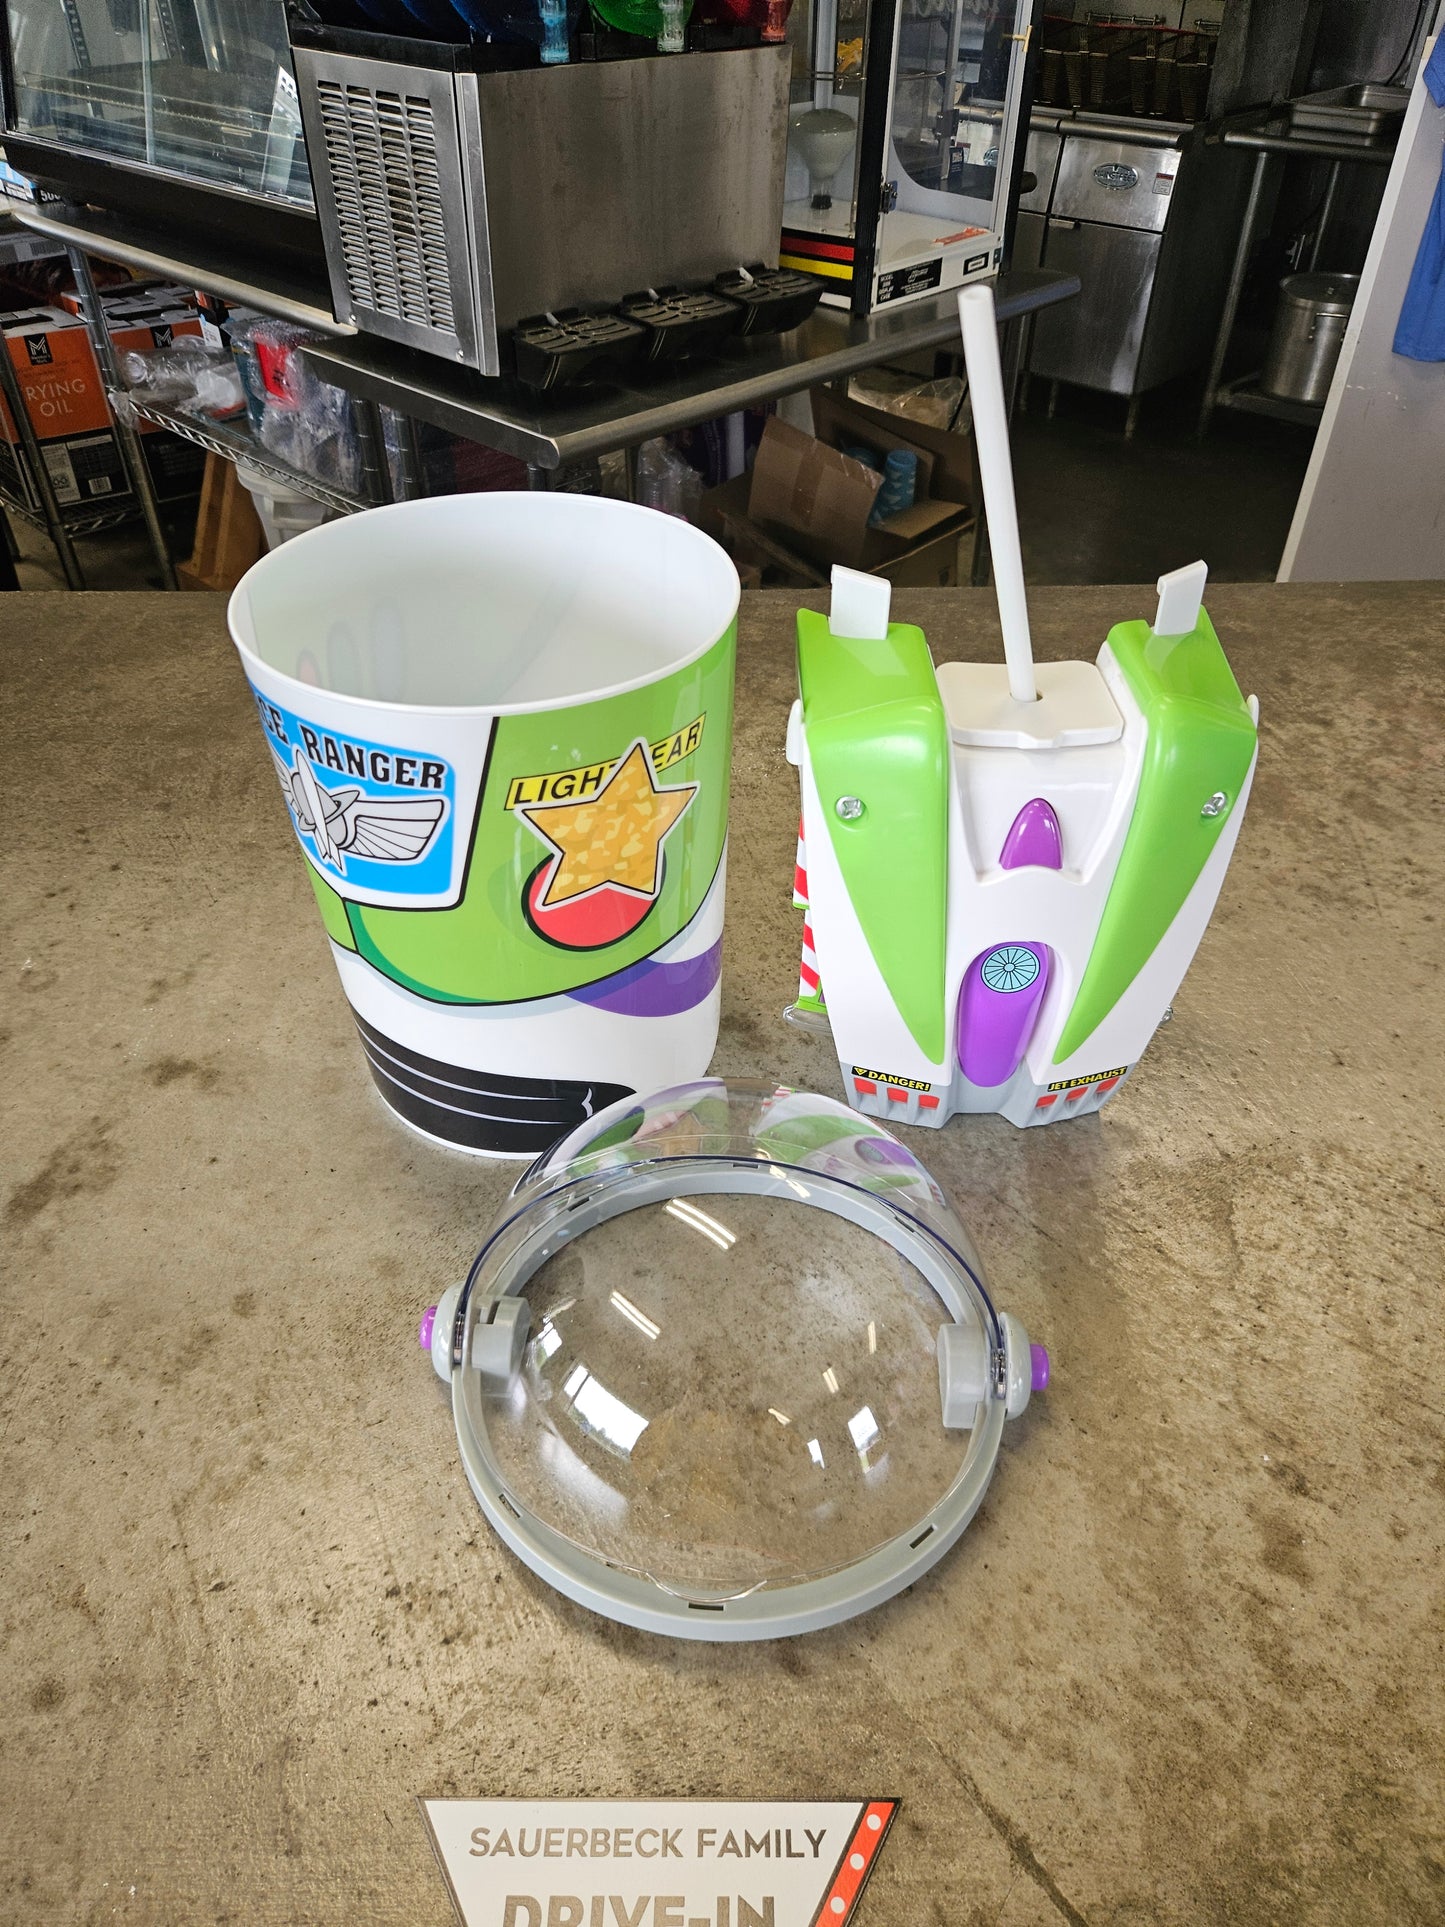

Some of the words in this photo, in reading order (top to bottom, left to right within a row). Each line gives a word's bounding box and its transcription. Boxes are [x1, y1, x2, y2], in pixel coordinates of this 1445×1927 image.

[25, 378, 86, 402] RYING
[40, 399, 73, 417] OIL
[300, 724, 446, 789] RANGER
[513, 722, 701, 804] LIGHEAR
[868, 1071, 930, 1091] DANGER!
[1049, 1081, 1069, 1091] JET
[1070, 1067, 1127, 1087] EXHAUST
[469, 1827, 684, 1857] SAUERBECK
[697, 1828, 827, 1858] FAMILY
